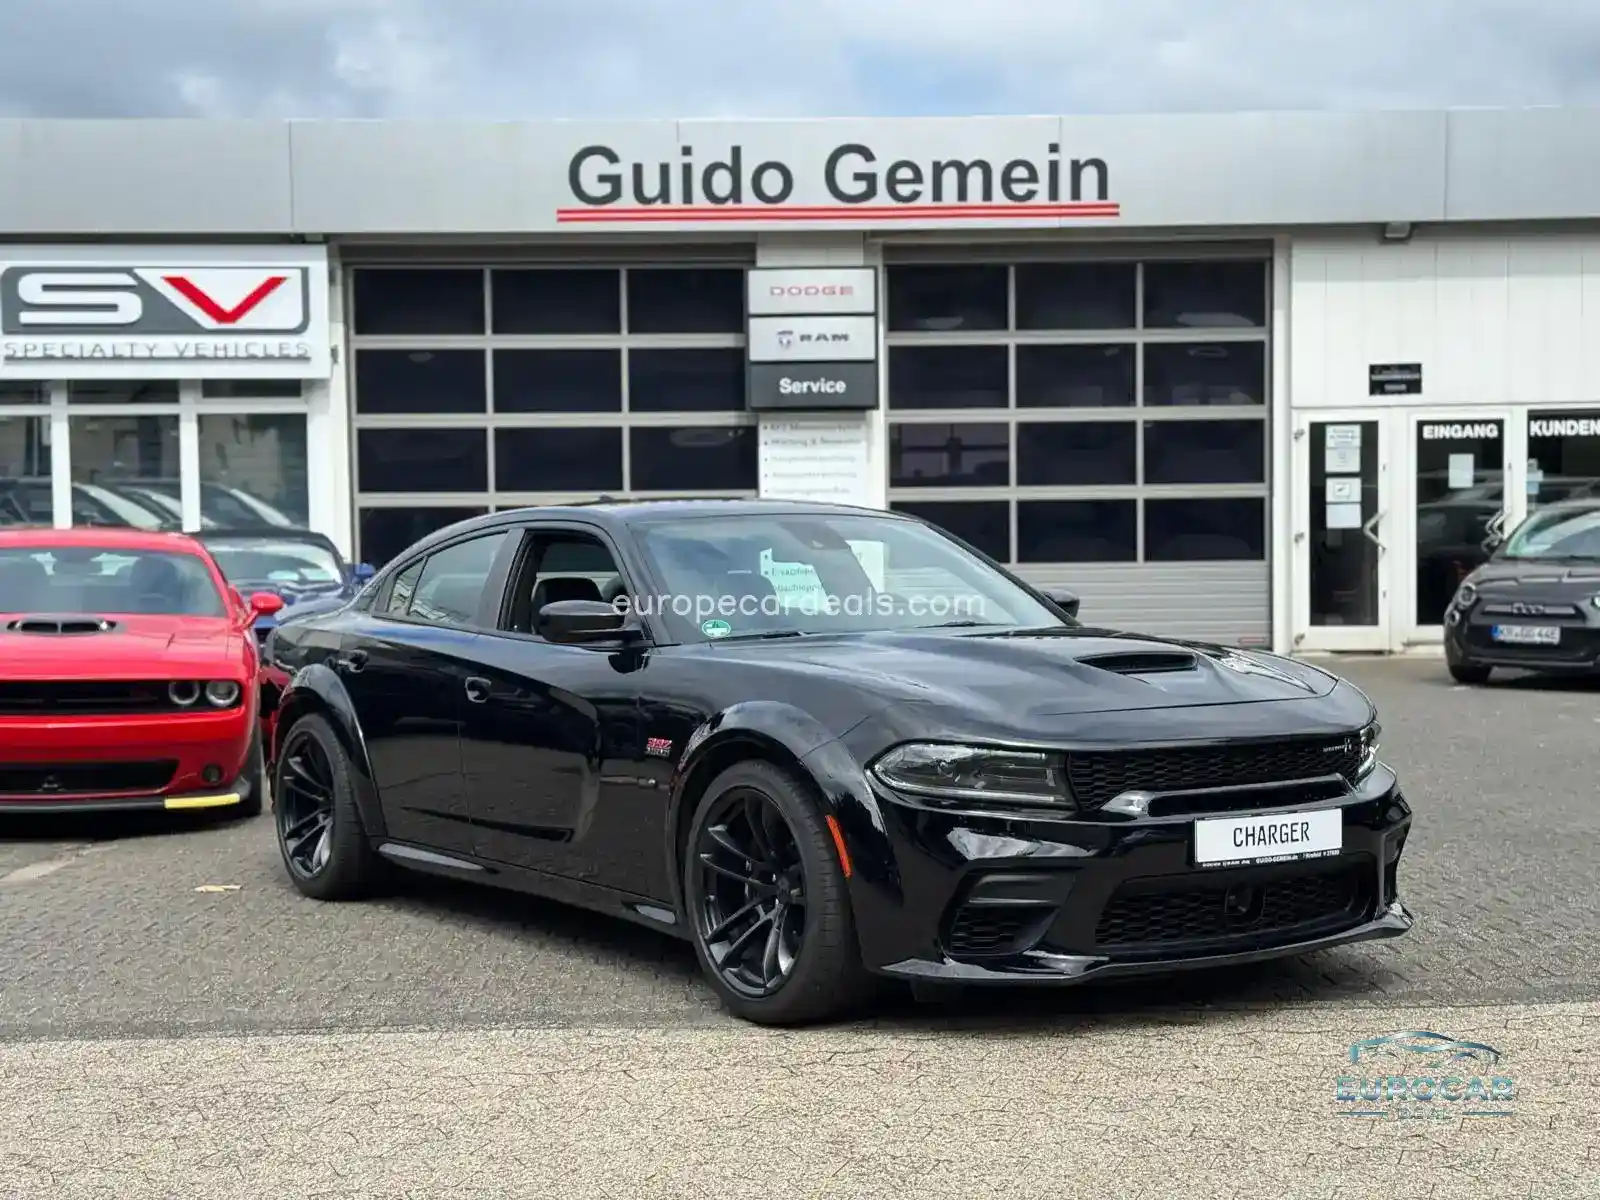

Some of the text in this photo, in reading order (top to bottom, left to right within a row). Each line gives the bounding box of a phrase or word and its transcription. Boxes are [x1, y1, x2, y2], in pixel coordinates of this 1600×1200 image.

[568, 143, 1109, 206] Guido Gemein
[17, 272, 289, 325] SV
[769, 285, 854, 296] DODGE
[799, 332, 850, 342] RAM
[3, 341, 310, 358] SPECIALTY VEHICLES
[778, 377, 847, 395] Service
[1422, 423, 1499, 439] EINGANG
[1233, 822, 1310, 847] CHARGER
